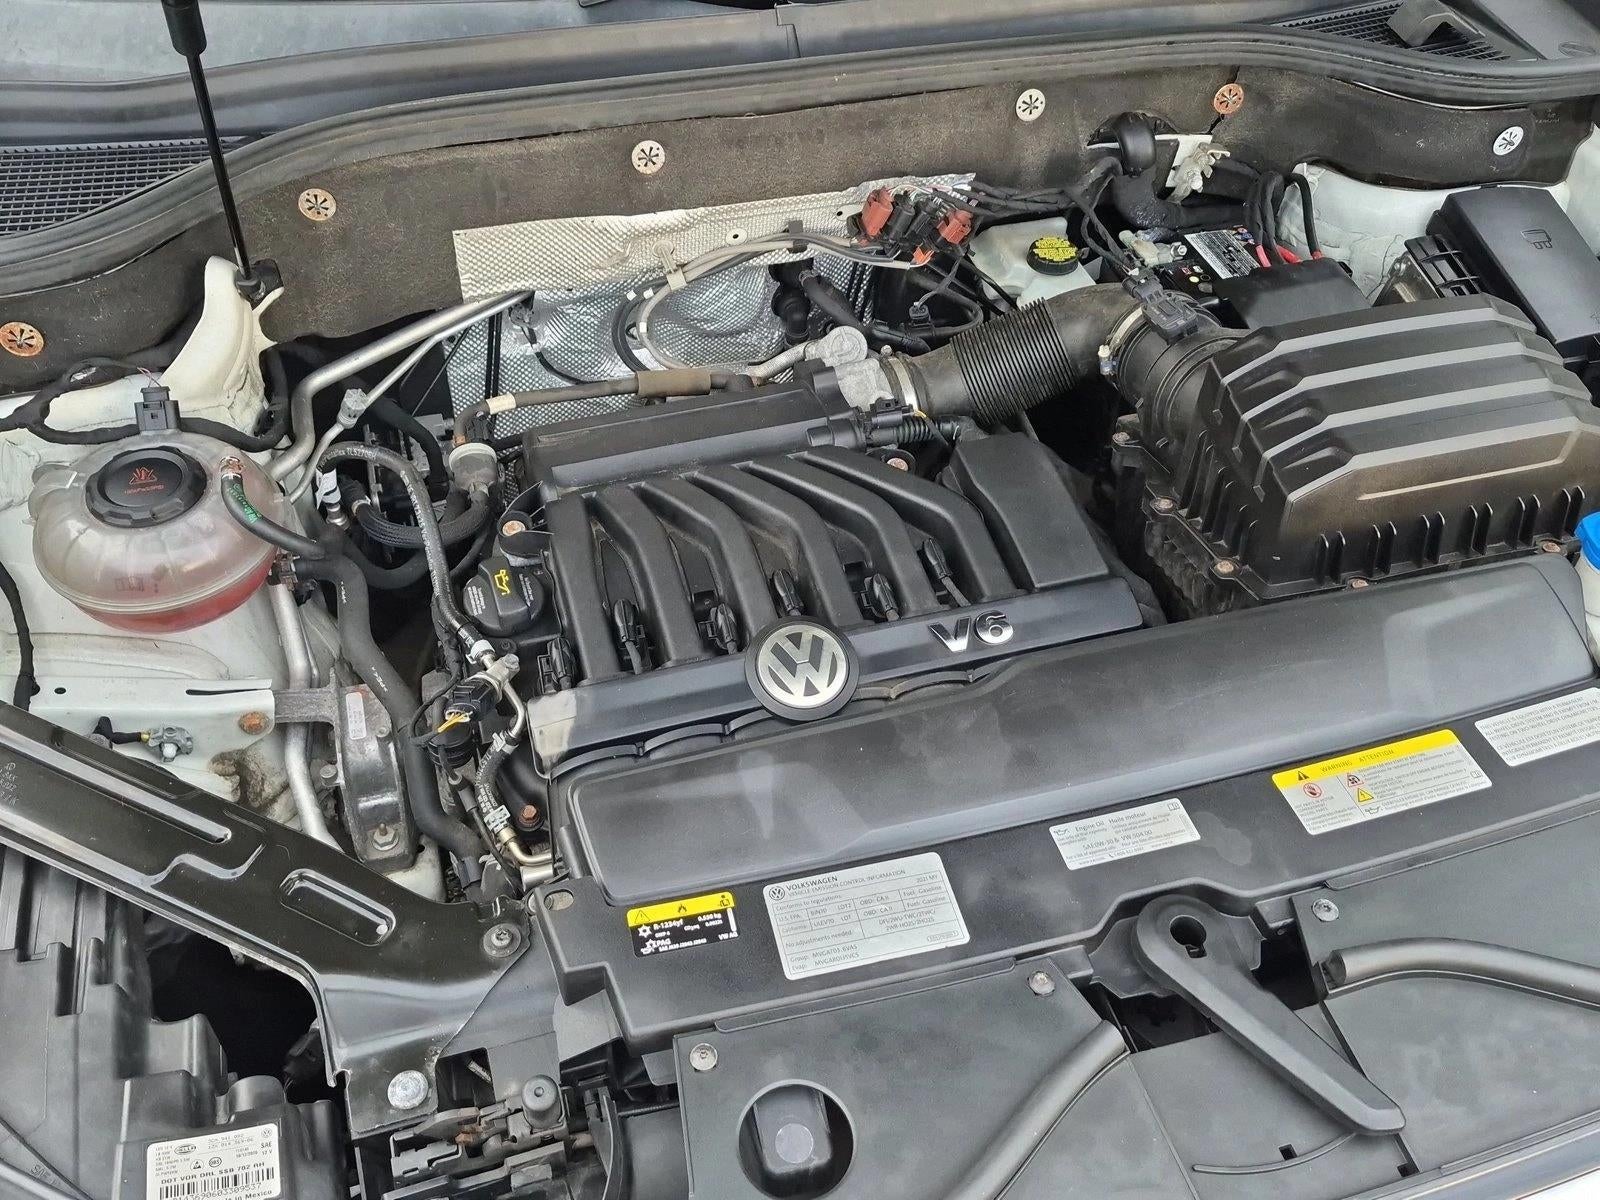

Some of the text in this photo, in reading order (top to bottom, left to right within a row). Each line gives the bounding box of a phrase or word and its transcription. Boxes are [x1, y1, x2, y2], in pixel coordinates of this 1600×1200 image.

[928, 610, 1013, 652] V6
[1319, 749, 1394, 772] WARNING ATTENTION
[786, 876, 838, 891] VOLKSWAGEN
[788, 869, 905, 897] VEHICLE EMISSION CONTROL INFORMATION
[653, 920, 683, 930] R-1234yf
[656, 938, 670, 946] PAG
[718, 932, 728, 940] VW
[245, 1190, 272, 1200] Mexico
